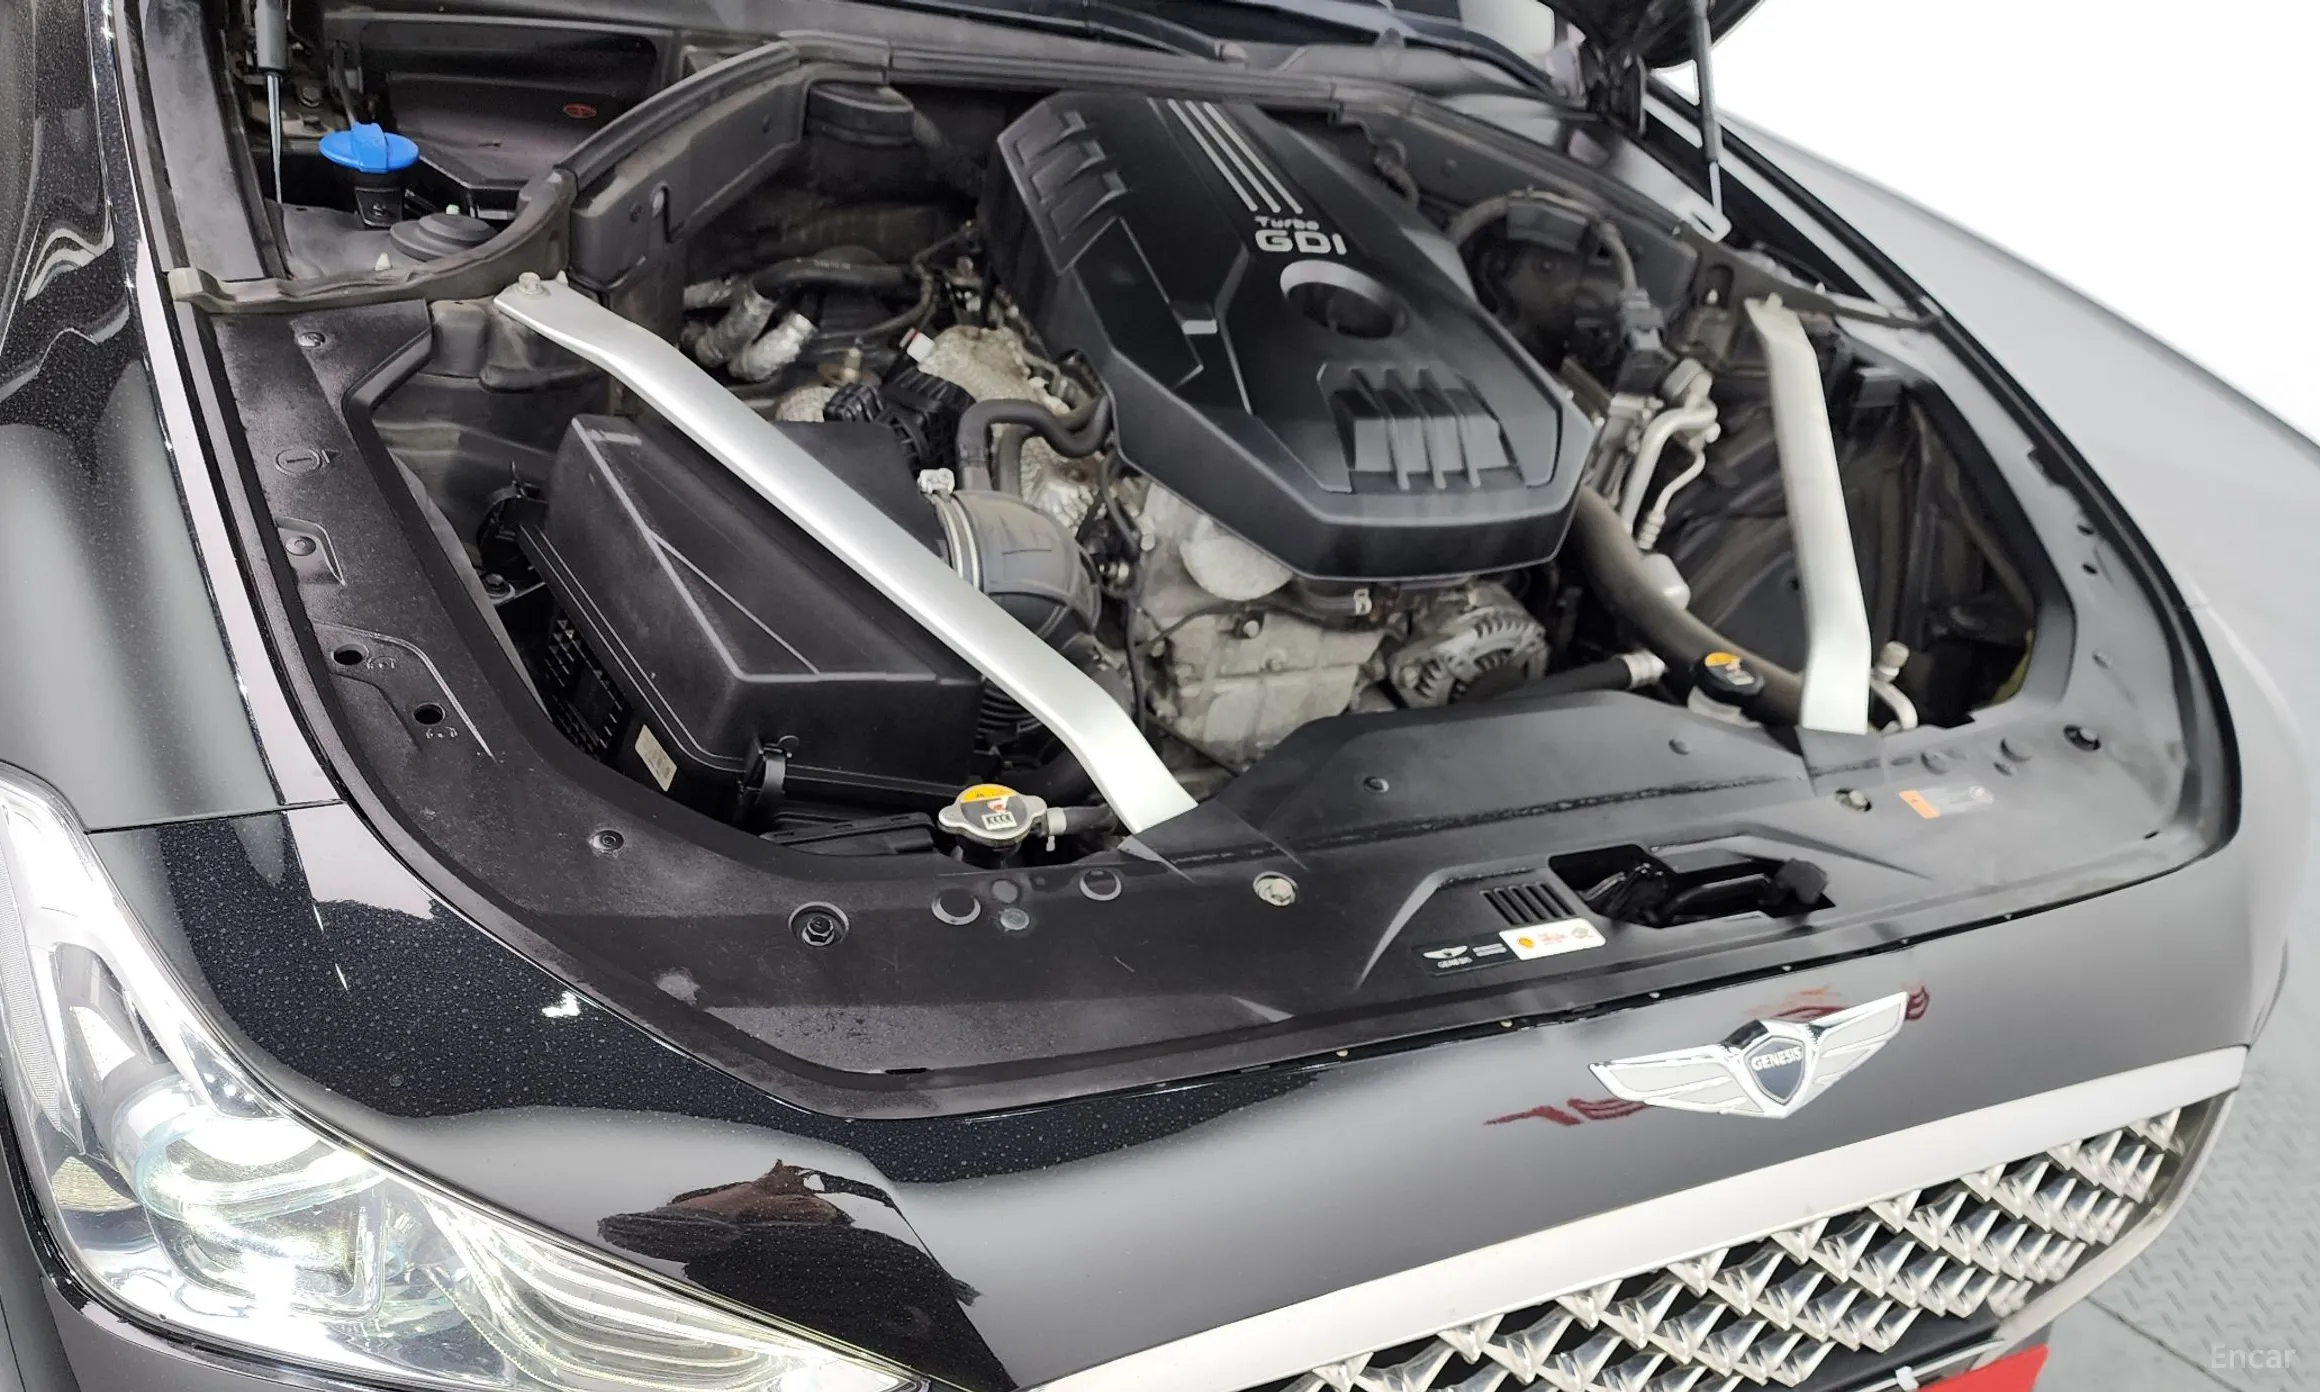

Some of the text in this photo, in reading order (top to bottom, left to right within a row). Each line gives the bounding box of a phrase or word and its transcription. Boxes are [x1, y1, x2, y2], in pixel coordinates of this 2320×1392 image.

[1254, 215, 1320, 231] Turbo
[1254, 229, 1348, 256] GDI
[1751, 1046, 1803, 1071] GENESIS
